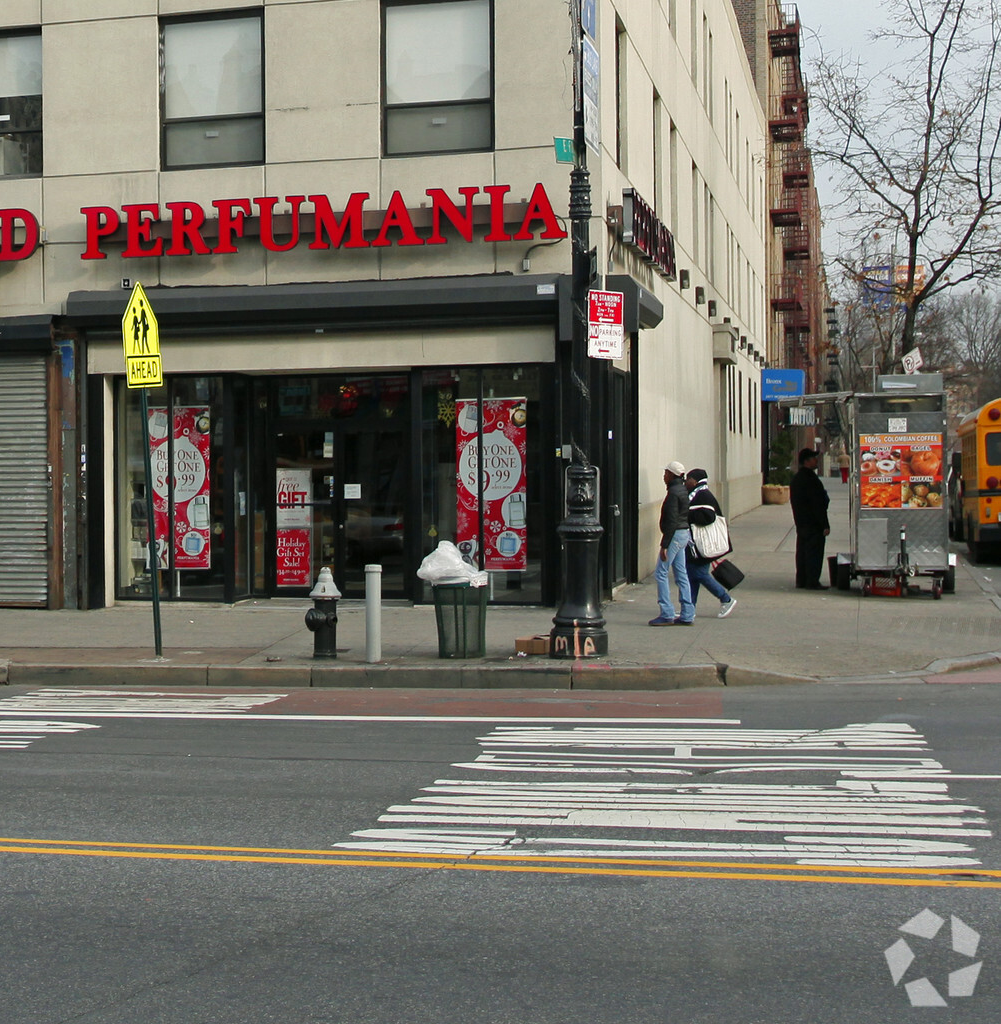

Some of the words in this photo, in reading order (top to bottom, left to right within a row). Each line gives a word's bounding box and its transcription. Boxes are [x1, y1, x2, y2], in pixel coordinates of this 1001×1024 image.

[80, 182, 568, 260] PERFUMANIA
[591, 293, 598, 301] NO
[599, 293, 621, 302] STANDING
[590, 325, 599, 337] NO
[599, 328, 621, 336] PARKING
[131, 361, 158, 379] AHEAD
[790, 407, 815, 425] TATTOO
[177, 449, 199, 461] ONE
[491, 443, 515, 456] ONE
[177, 460, 201, 473] ONE
[468, 456, 491, 469] GT
[491, 455, 517, 469] ONE
[278, 477, 299, 492] free
[278, 491, 307, 509] GIFT
[278, 537, 306, 550] Holiday
[276, 547, 292, 557] Gift
[293, 547, 305, 557] Set
[283, 557, 300, 567] Sale!
